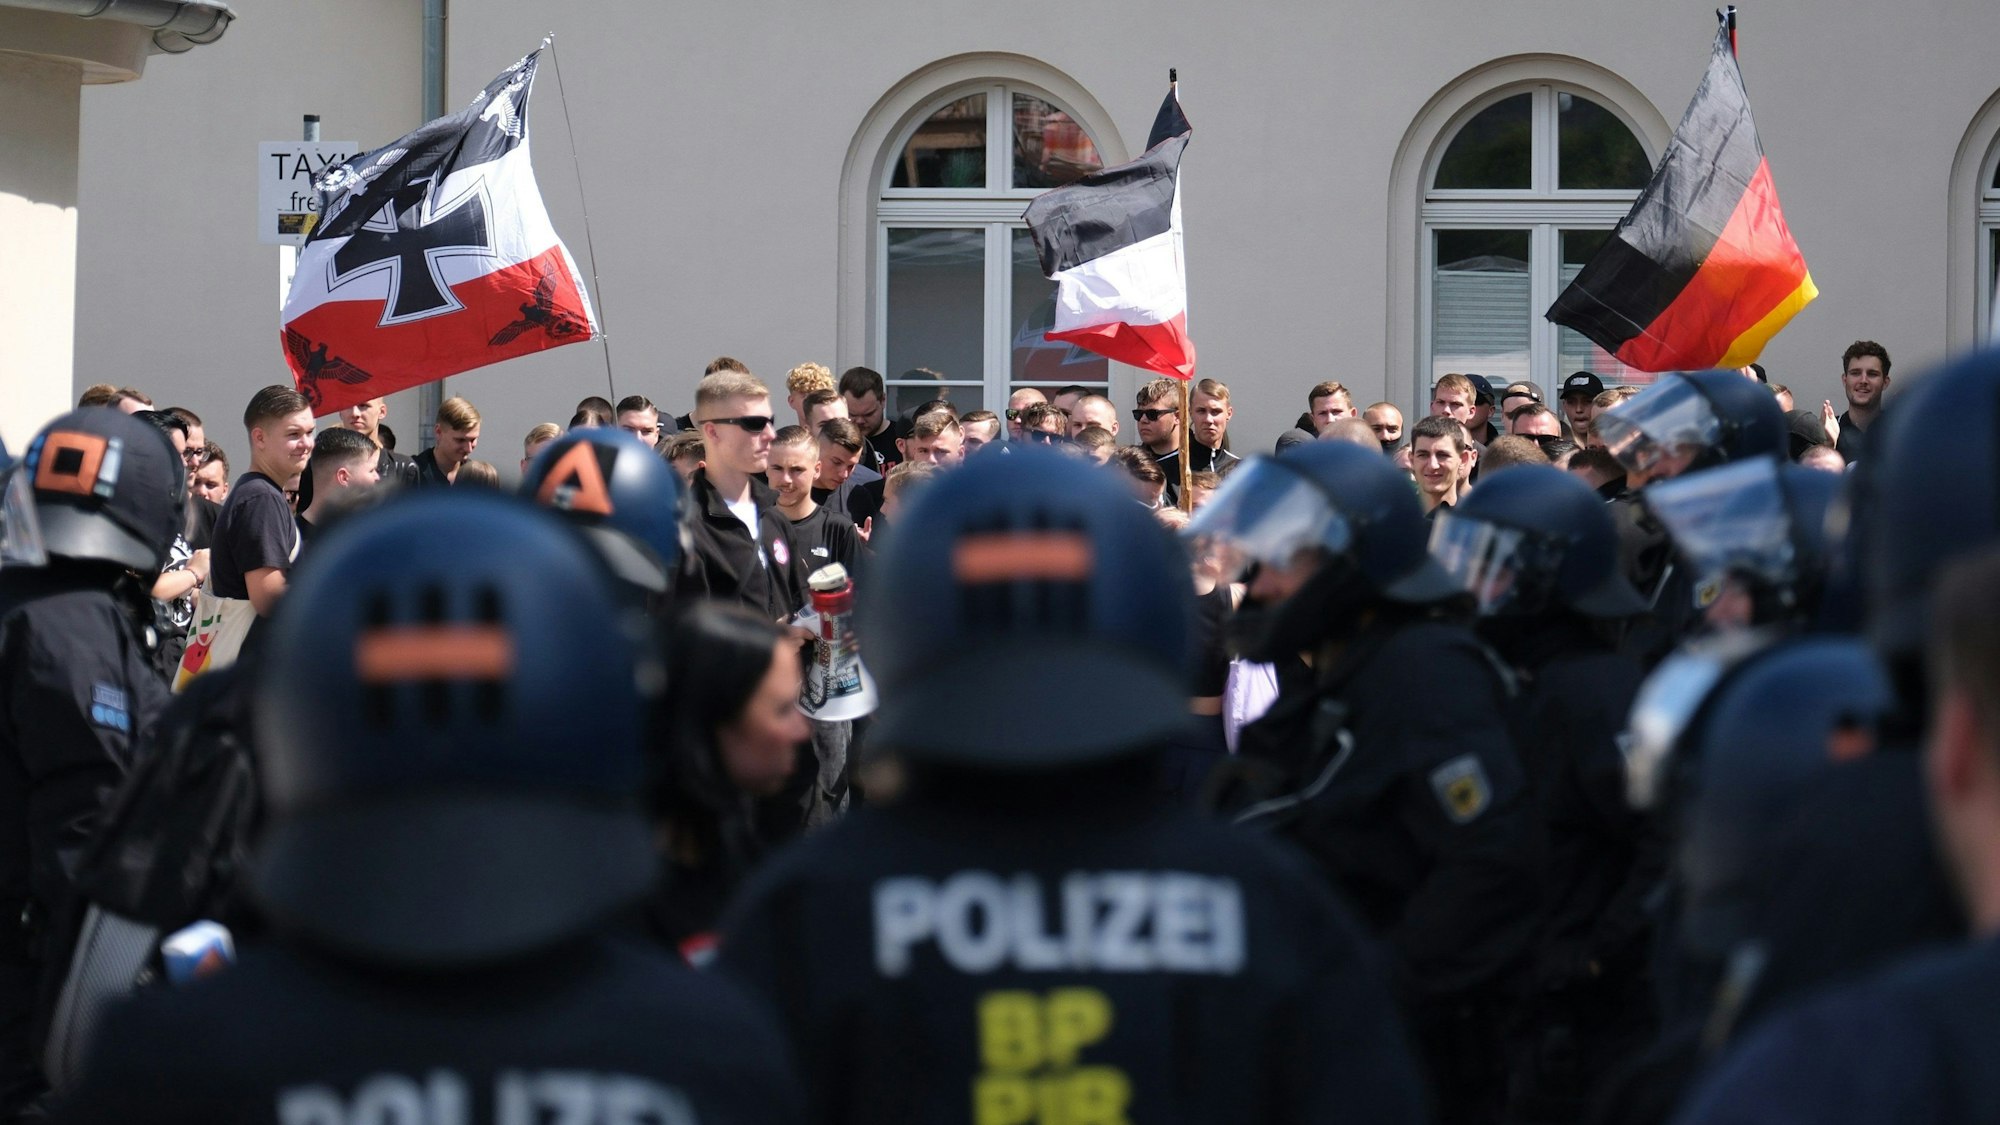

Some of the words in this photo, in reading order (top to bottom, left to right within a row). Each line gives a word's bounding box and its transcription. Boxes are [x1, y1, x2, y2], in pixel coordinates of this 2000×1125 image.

[271, 153, 345, 180] TA
[290, 191, 318, 212] fre
[874, 870, 1244, 975] POLIZEI
[977, 986, 1112, 1070] BP
